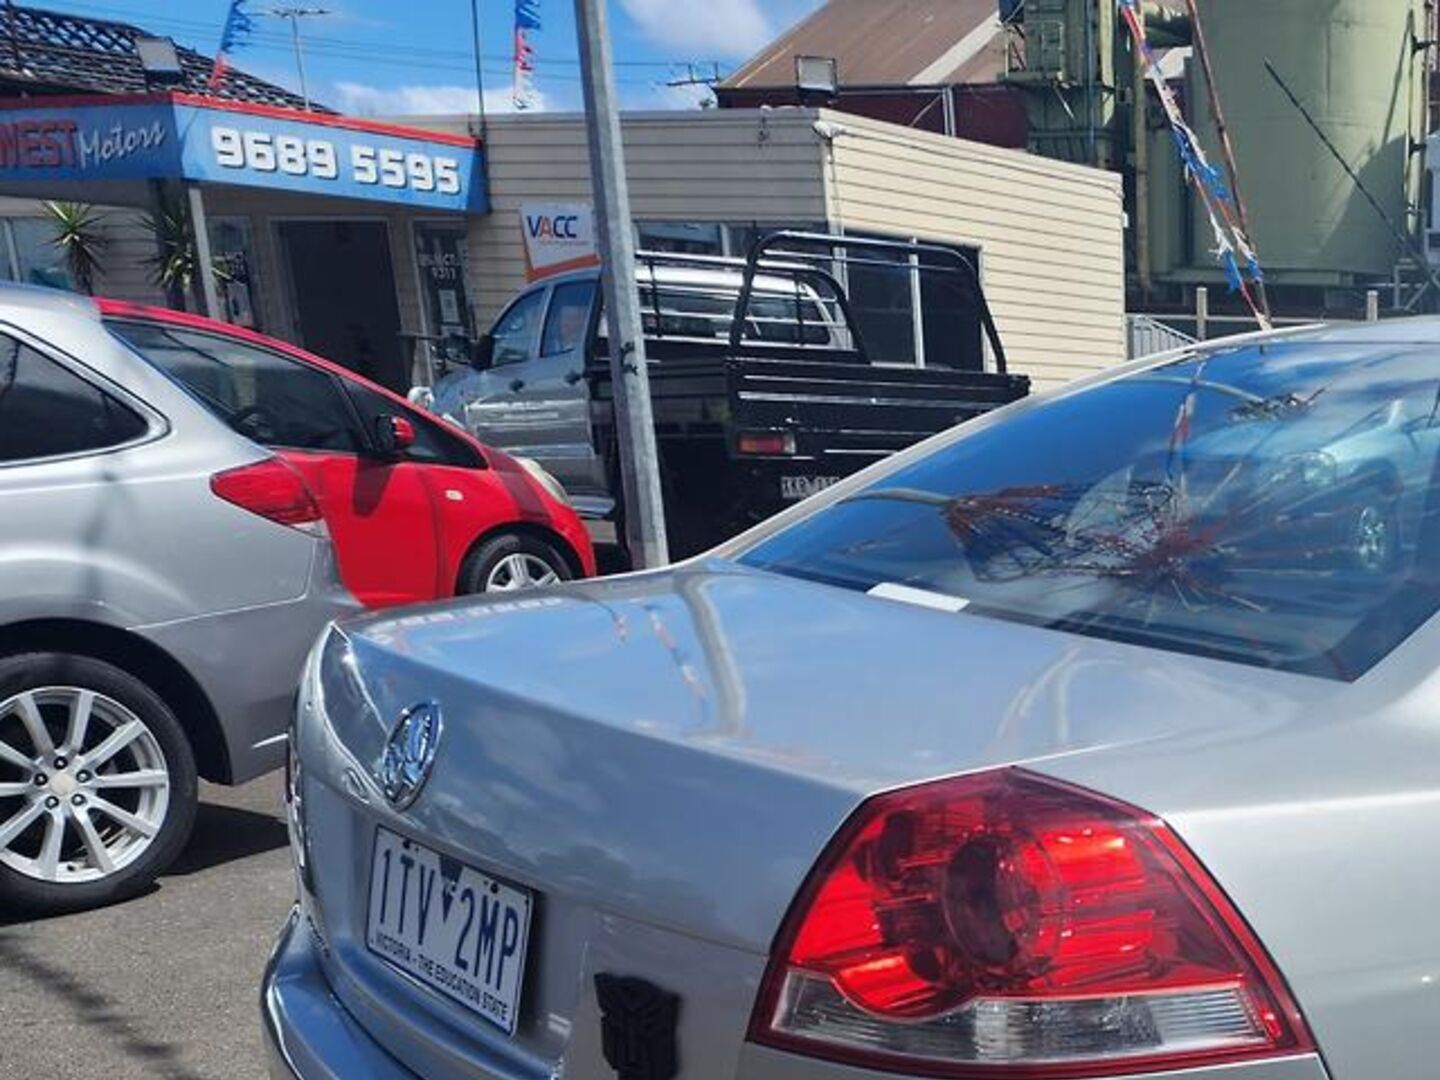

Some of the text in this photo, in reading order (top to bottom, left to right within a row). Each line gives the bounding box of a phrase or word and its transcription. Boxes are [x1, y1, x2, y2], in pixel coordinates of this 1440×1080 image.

[77, 120, 165, 170] Motors
[212, 126, 461, 194] 9689 5595
[527, 215, 578, 238] VACC
[418, 953, 434, 977] THE
[435, 962, 481, 1004] EDUCATION
[483, 991, 509, 1021] STATE
